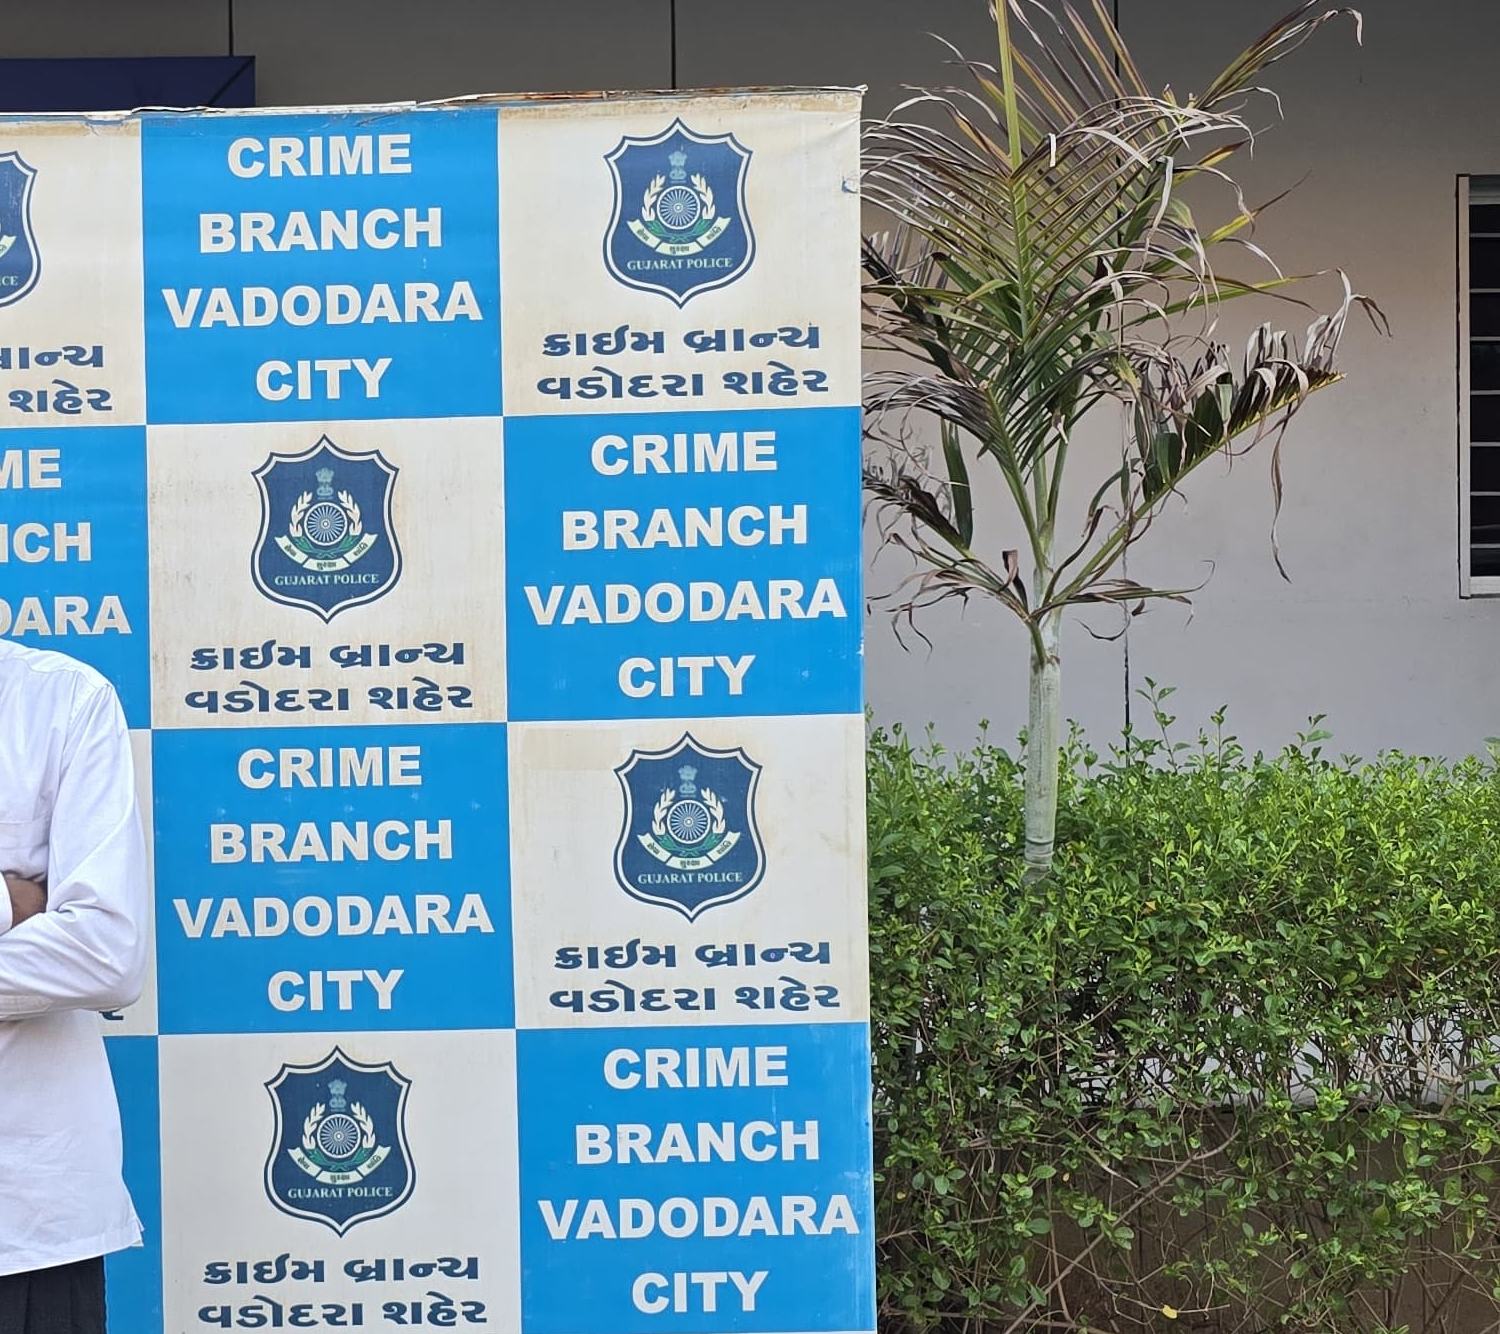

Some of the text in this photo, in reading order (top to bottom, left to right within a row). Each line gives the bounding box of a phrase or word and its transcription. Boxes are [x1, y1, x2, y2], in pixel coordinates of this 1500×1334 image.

[227, 133, 412, 179] CRIME
[199, 207, 442, 254] BRANCH
[626, 257, 734, 270] GUJARAT POLICE
[161, 280, 483, 329] VADODARA
[543, 324, 820, 357] ક્રાઈમ બ્રાન્ચ
[8, 379, 113, 415] શહેર
[256, 357, 392, 402] CITY
[536, 360, 829, 400] વડોદરા શહેર
[591, 430, 778, 476] CRIME
[562, 504, 807, 551] BRANCH
[274, 573, 381, 586] GUJARAT POLICE
[523, 578, 847, 626] VADODARA
[191, 639, 465, 671] ક્રાઈમ બ્રાન્ચ
[618, 654, 756, 698] CITY
[184, 676, 473, 714] વડોદરા શહેર
[237, 745, 422, 789] CRIME
[210, 819, 453, 864] BRANCH
[637, 871, 745, 884] GUJARAT POLICE
[173, 893, 495, 939] VADODARA
[554, 938, 830, 970] ક્રાઈમ બ્રાન્ચ
[267, 969, 404, 1012] CITY
[549, 975, 841, 1013] વડોદરા શહેર
[603, 1045, 789, 1090] CRIME
[575, 1120, 819, 1165] BRANCH
[287, 1186, 395, 1199] GUJARAT POLICE
[538, 1194, 860, 1240] VADODARA
[203, 1253, 479, 1285] ક્રાઈમ બ્રાન્ચ
[197, 1290, 488, 1329] વડોદરા શહેર
[632, 1271, 768, 1314] CITY
